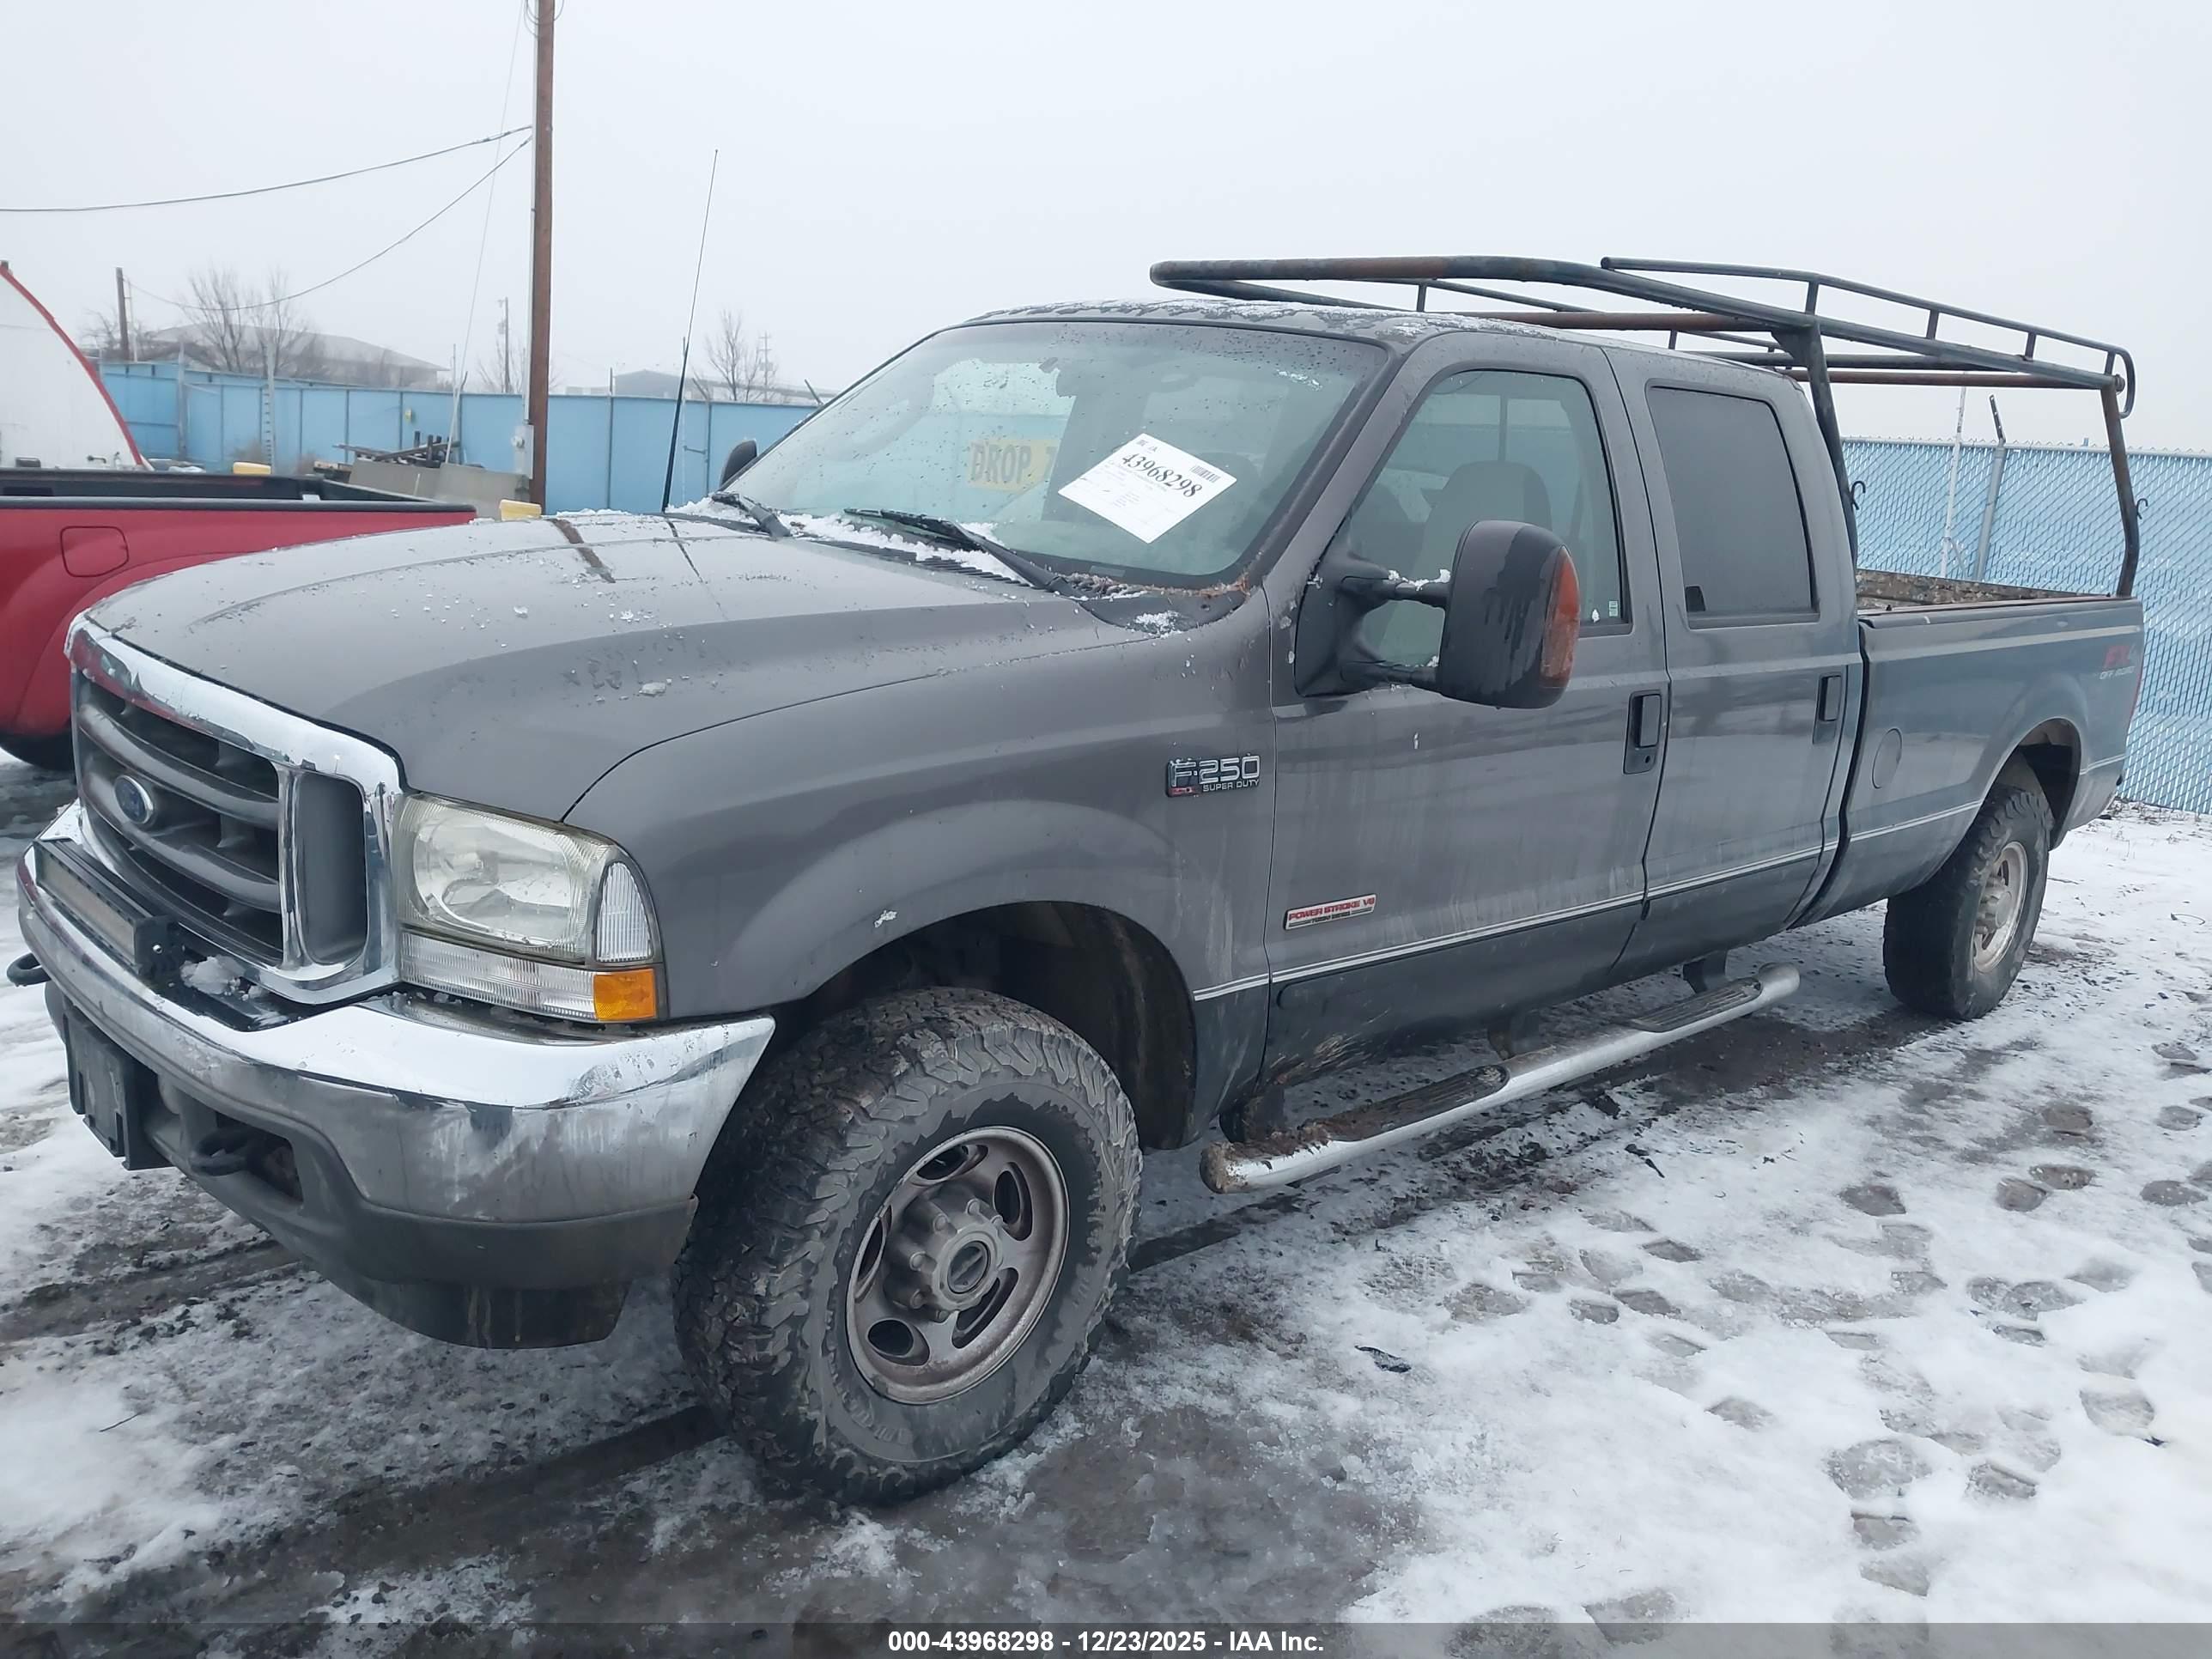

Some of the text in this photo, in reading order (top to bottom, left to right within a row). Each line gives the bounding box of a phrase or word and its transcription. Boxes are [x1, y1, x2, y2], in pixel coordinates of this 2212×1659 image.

[970, 442, 1031, 483] DROP
[1122, 453, 1202, 497] 43968298
[1170, 756, 1261, 787] F-250
[1203, 781, 1233, 792] SUPER
[1237, 779, 1260, 787] DUTY
[1288, 908, 1323, 921] POWER
[1323, 901, 1361, 913] STROKE
[1363, 897, 1375, 906] V8
